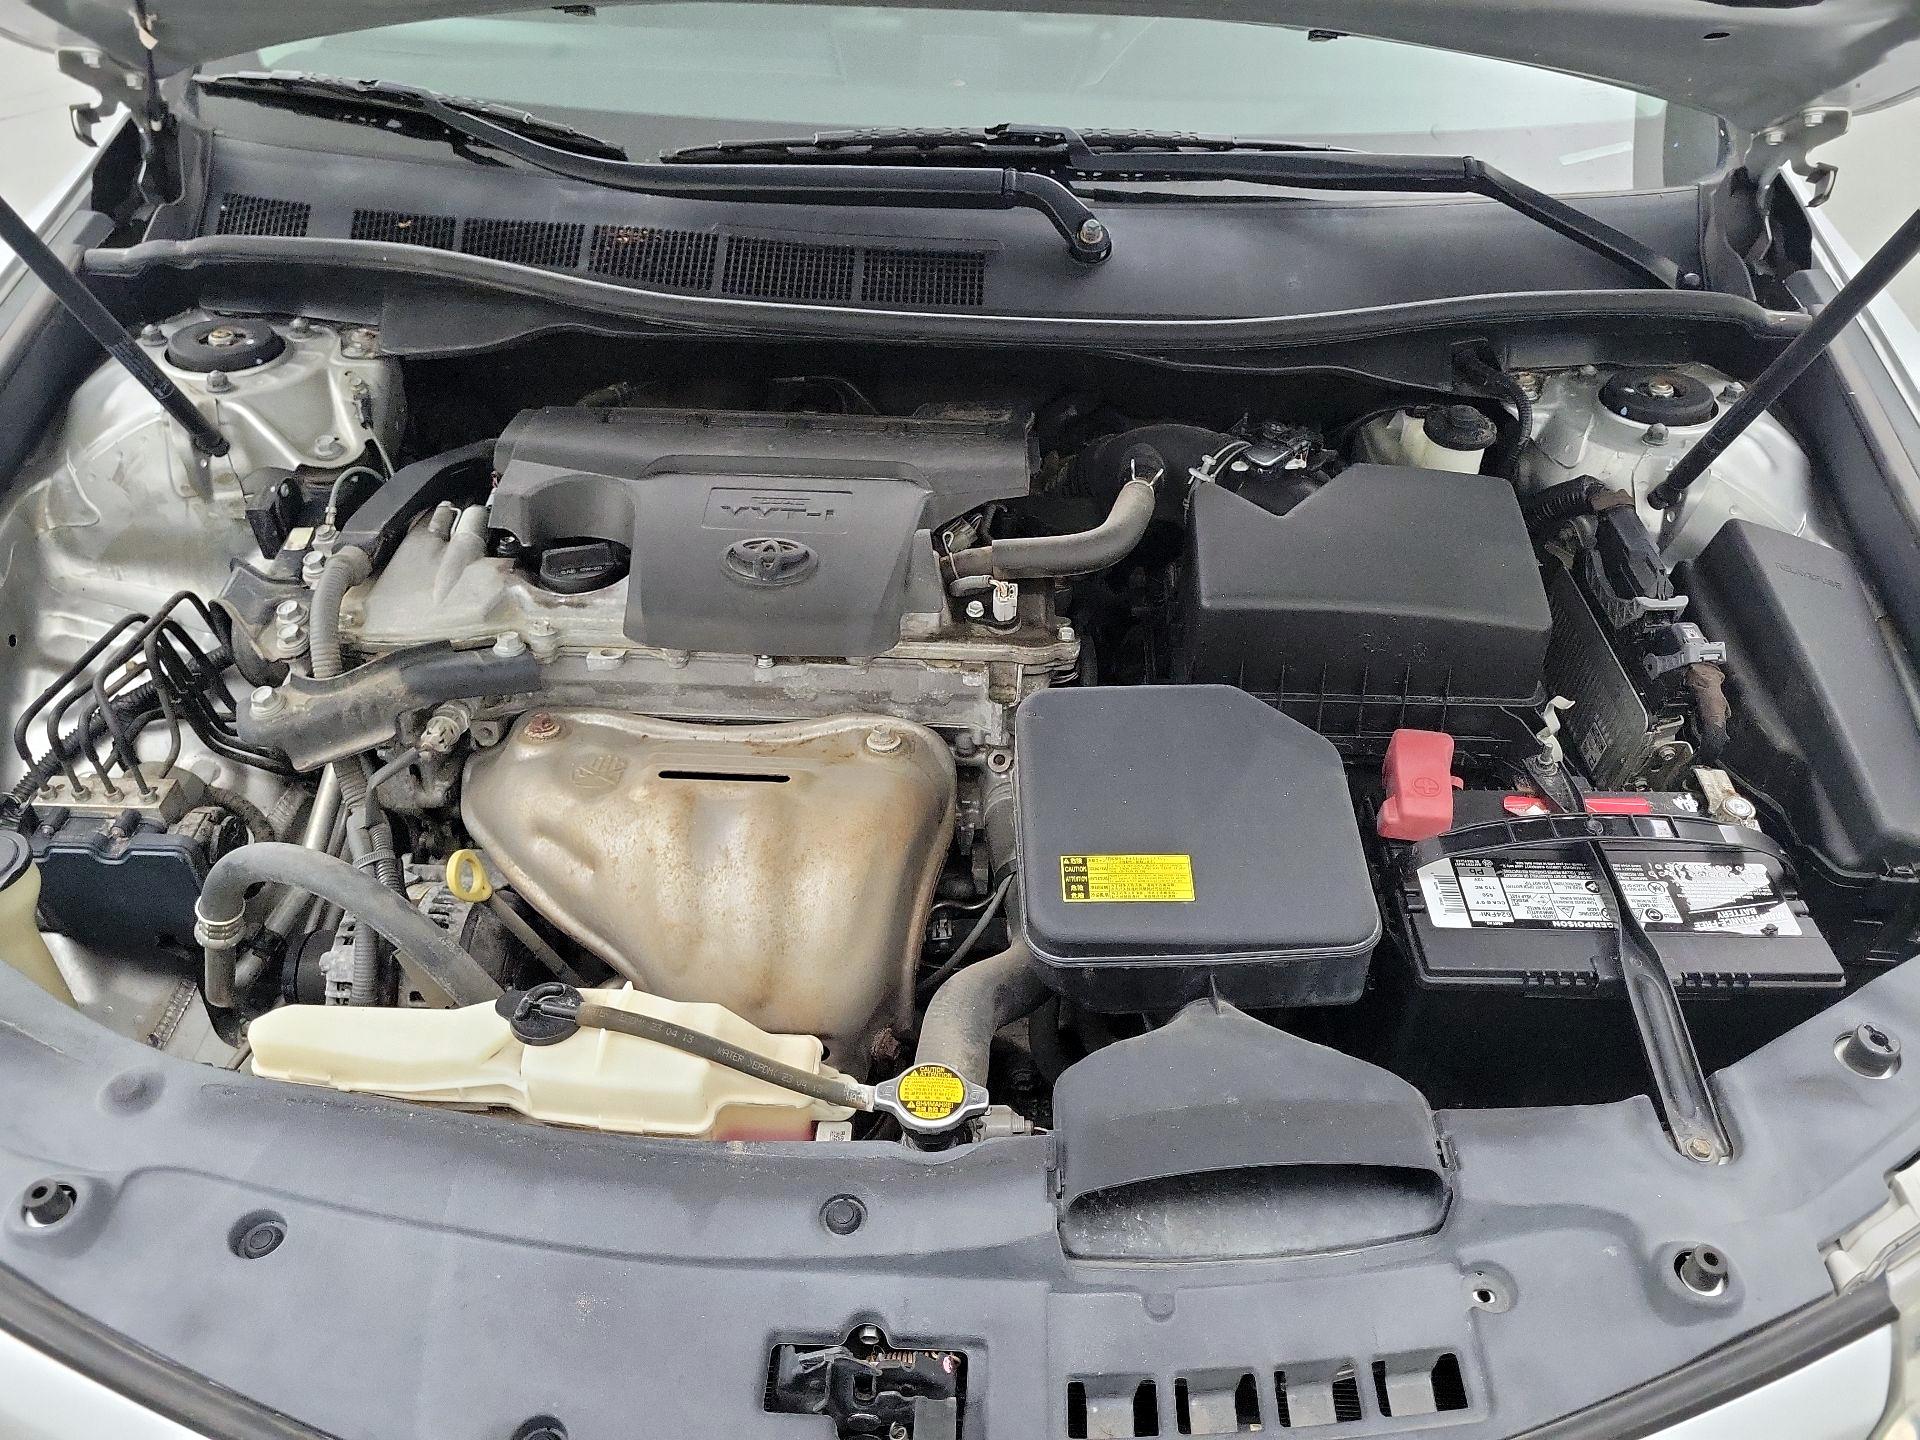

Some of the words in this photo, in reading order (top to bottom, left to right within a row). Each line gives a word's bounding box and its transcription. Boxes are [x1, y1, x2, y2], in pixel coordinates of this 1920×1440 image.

[1469, 868, 1485, 876] Pb
[1693, 910, 1786, 930] MAINTENANCE-FREE
[1715, 908, 1758, 919] BATTERY
[1551, 920, 1614, 928] GER/POISON
[666, 1028, 678, 1037] 04
[682, 1033, 696, 1043] 13
[715, 1046, 745, 1063] WATER
